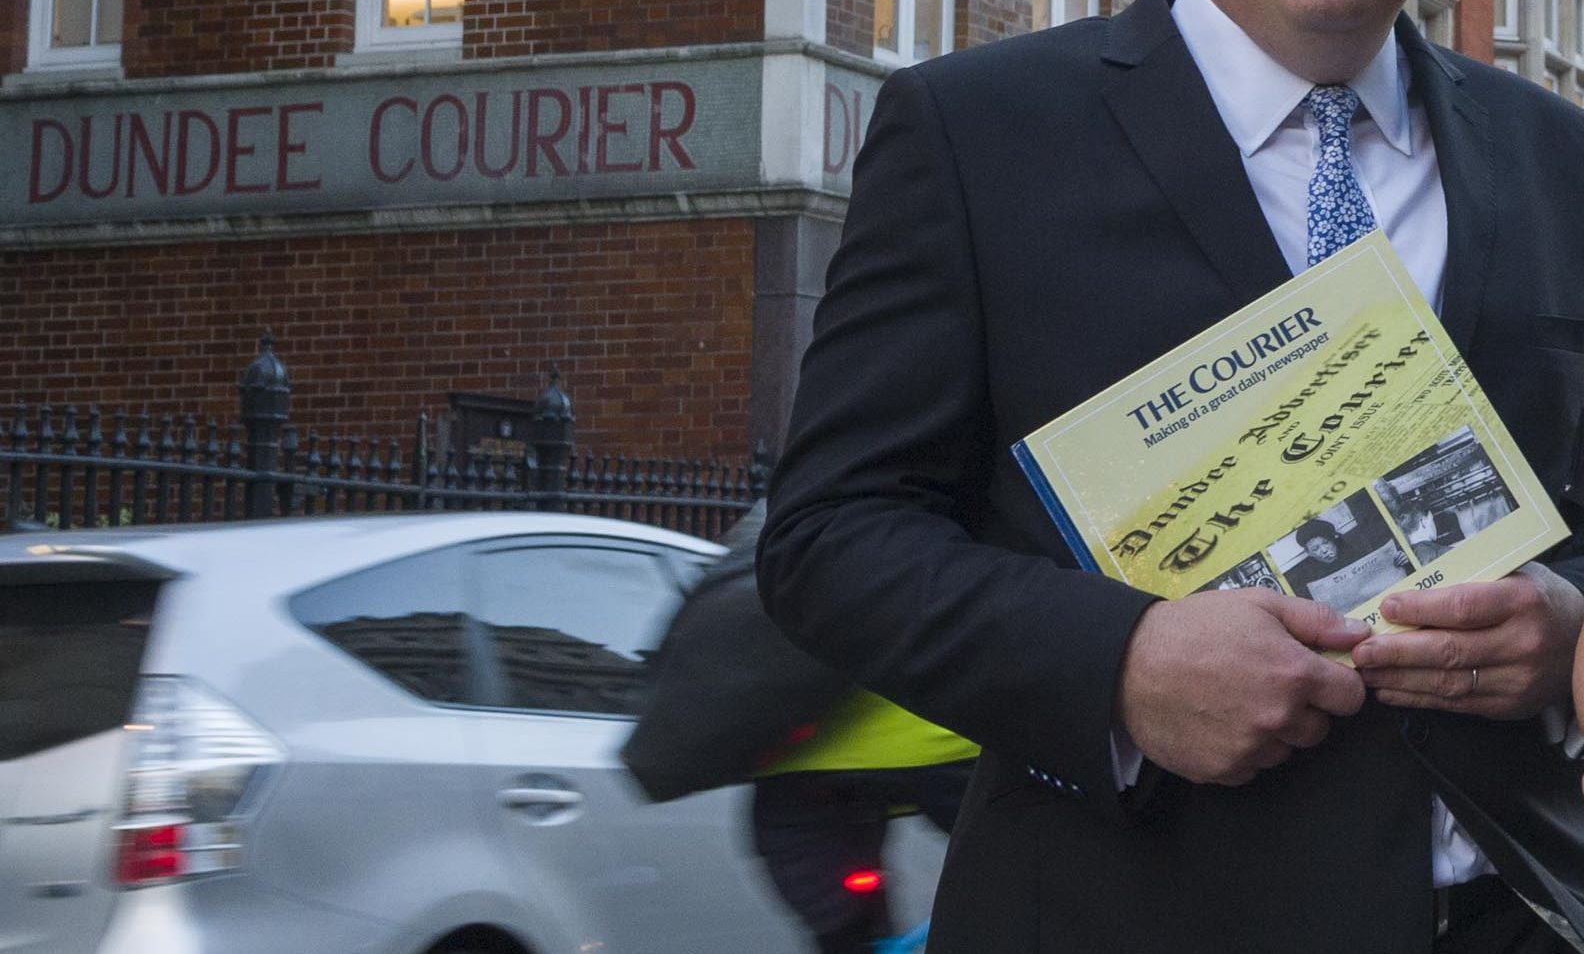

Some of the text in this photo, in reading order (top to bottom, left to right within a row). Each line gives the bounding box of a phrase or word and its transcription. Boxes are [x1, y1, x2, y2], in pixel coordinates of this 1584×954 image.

[27, 81, 697, 205] DUNDEE COURIER
[1126, 306, 1323, 431] THE COURIER
[1143, 331, 1331, 448] Making of a great daily newspaper
[1109, 455, 1239, 558] Dundee
[1239, 328, 1382, 446] Advertiser
[1158, 478, 1275, 573] The
[1281, 330, 1431, 464] Courier
[1277, 421, 1300, 442] AND
[1315, 400, 1385, 467] JOINT ISSUE
[1319, 479, 1347, 504] TO
[1414, 569, 1445, 591] 2016
